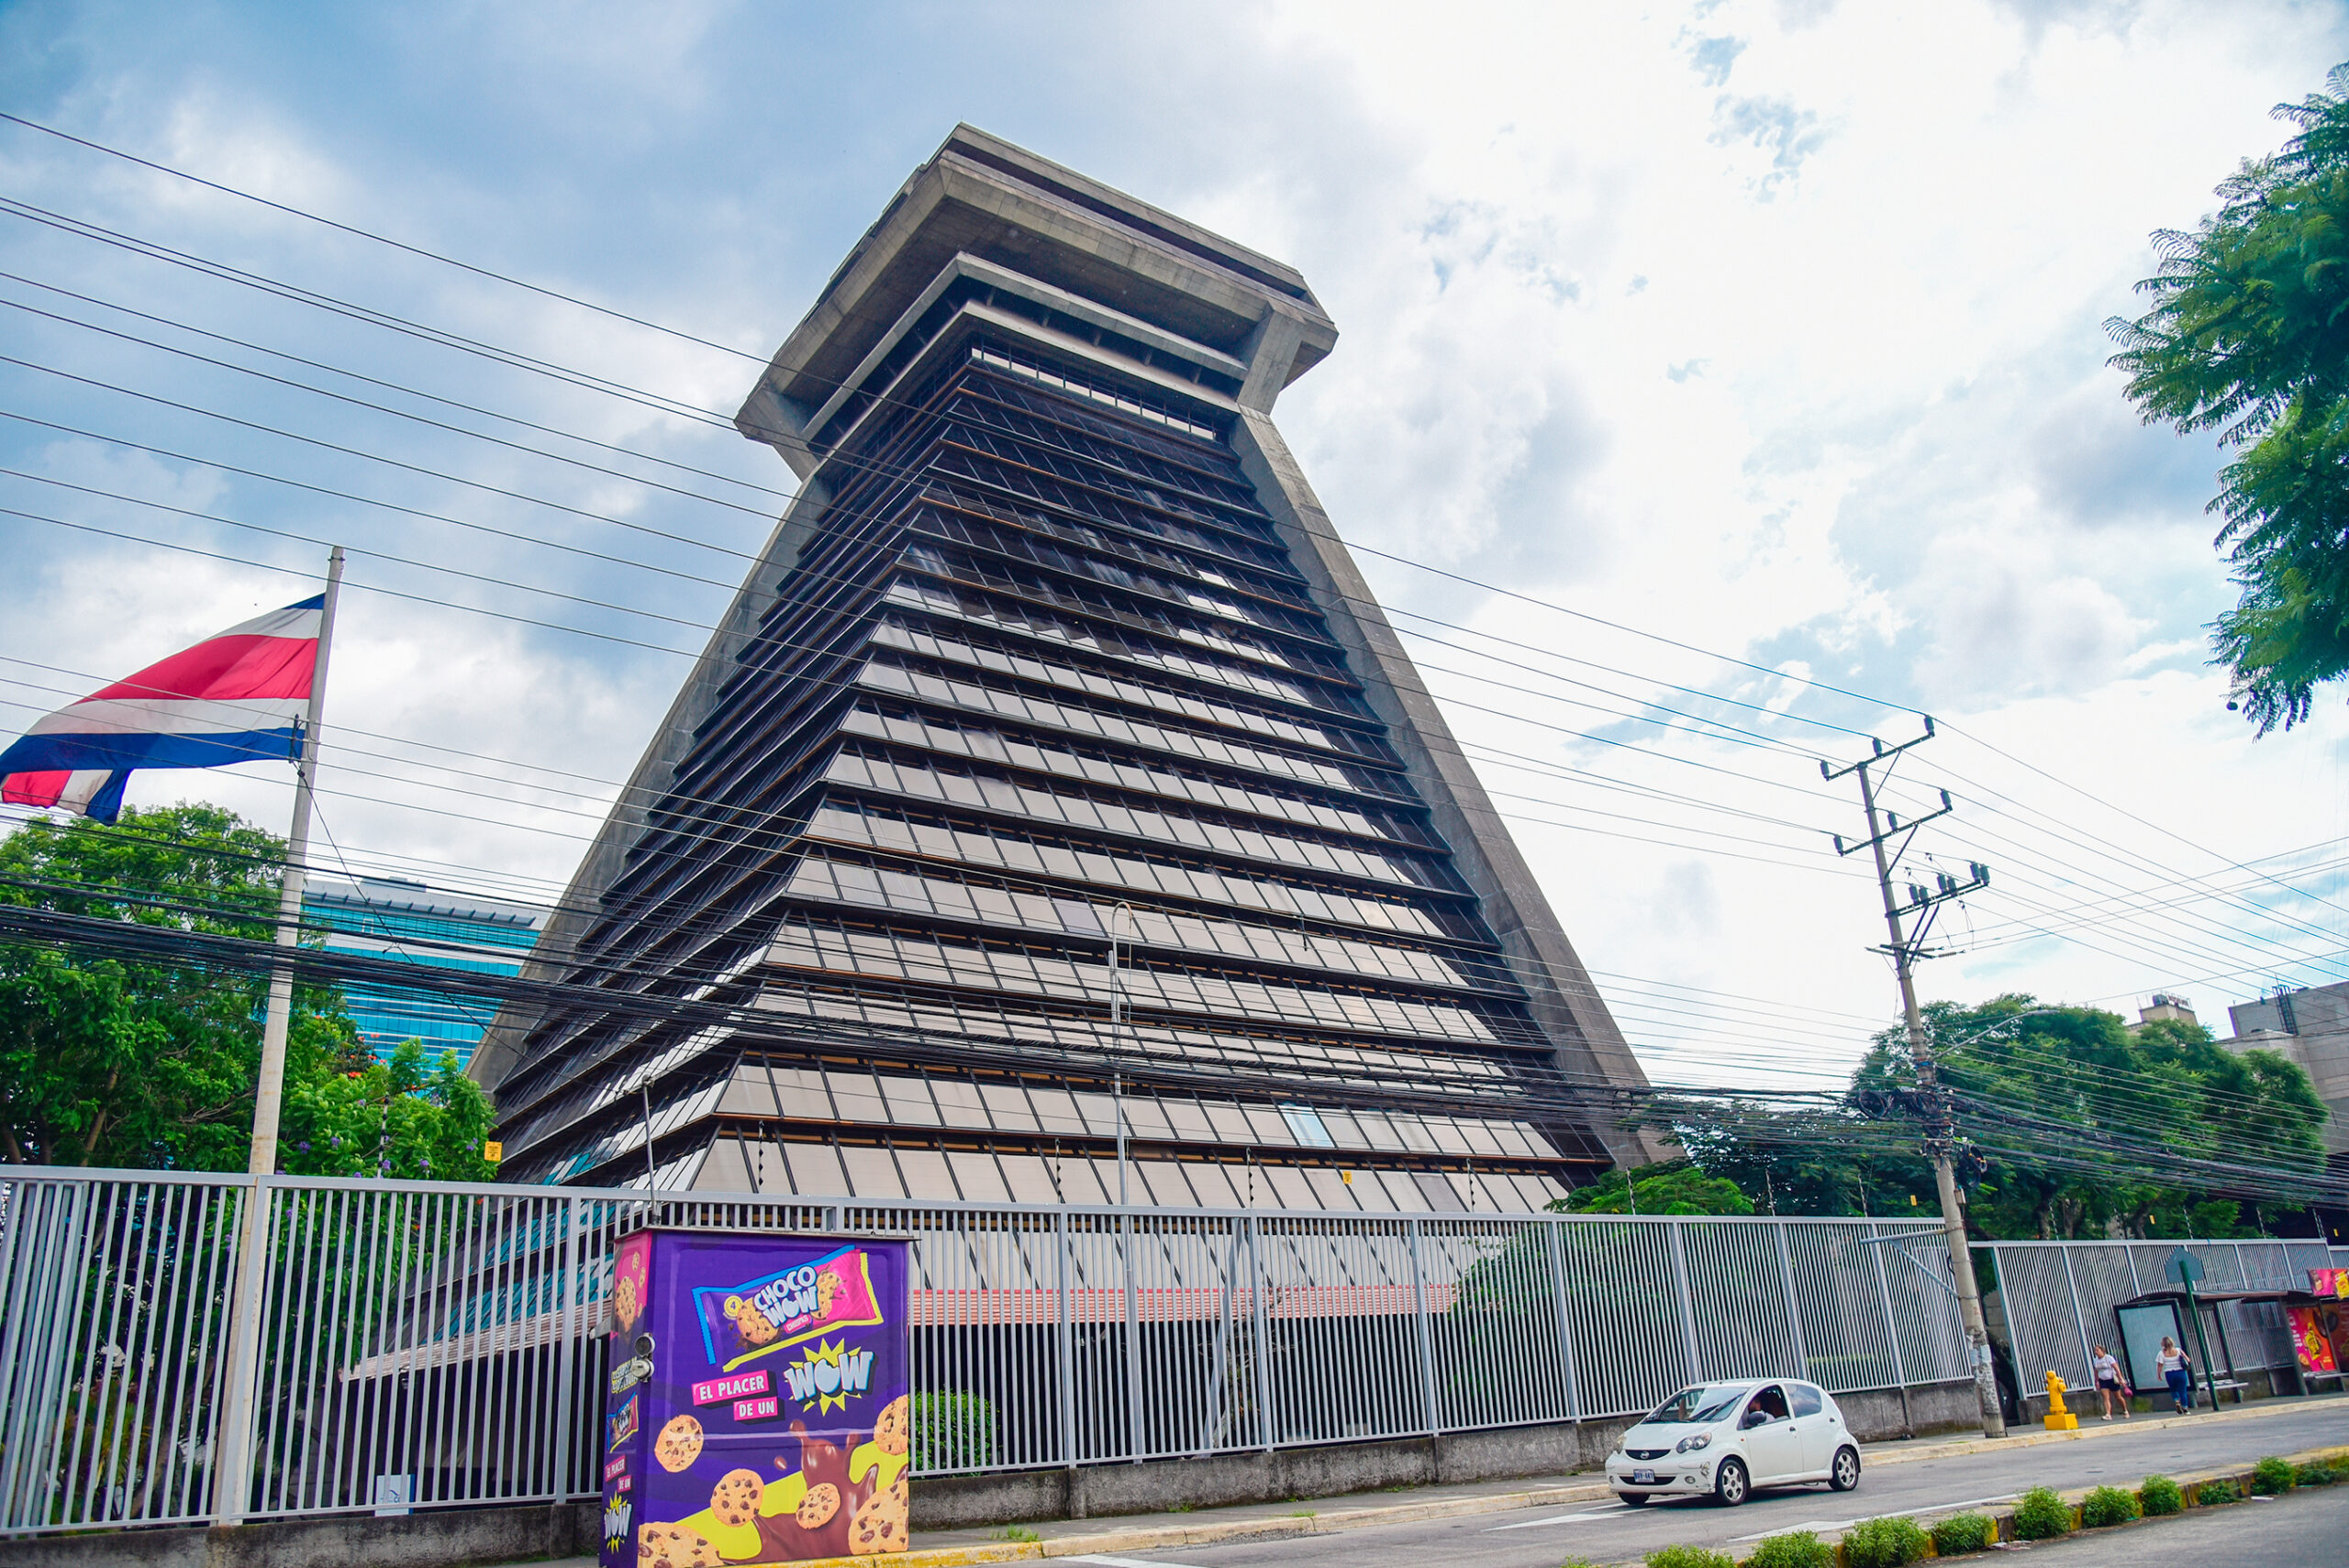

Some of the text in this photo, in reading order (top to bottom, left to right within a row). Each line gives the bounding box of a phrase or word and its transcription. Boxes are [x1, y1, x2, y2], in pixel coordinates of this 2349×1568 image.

[753, 1265, 818, 1311] CHOCO
[763, 1285, 818, 1328] WOW
[699, 1375, 765, 1401] EL PLACER
[784, 1351, 874, 1403] WOW
[739, 1401, 775, 1418] DE UN
[611, 1458, 625, 1475] PLACER
[604, 1503, 632, 1540] WOW
